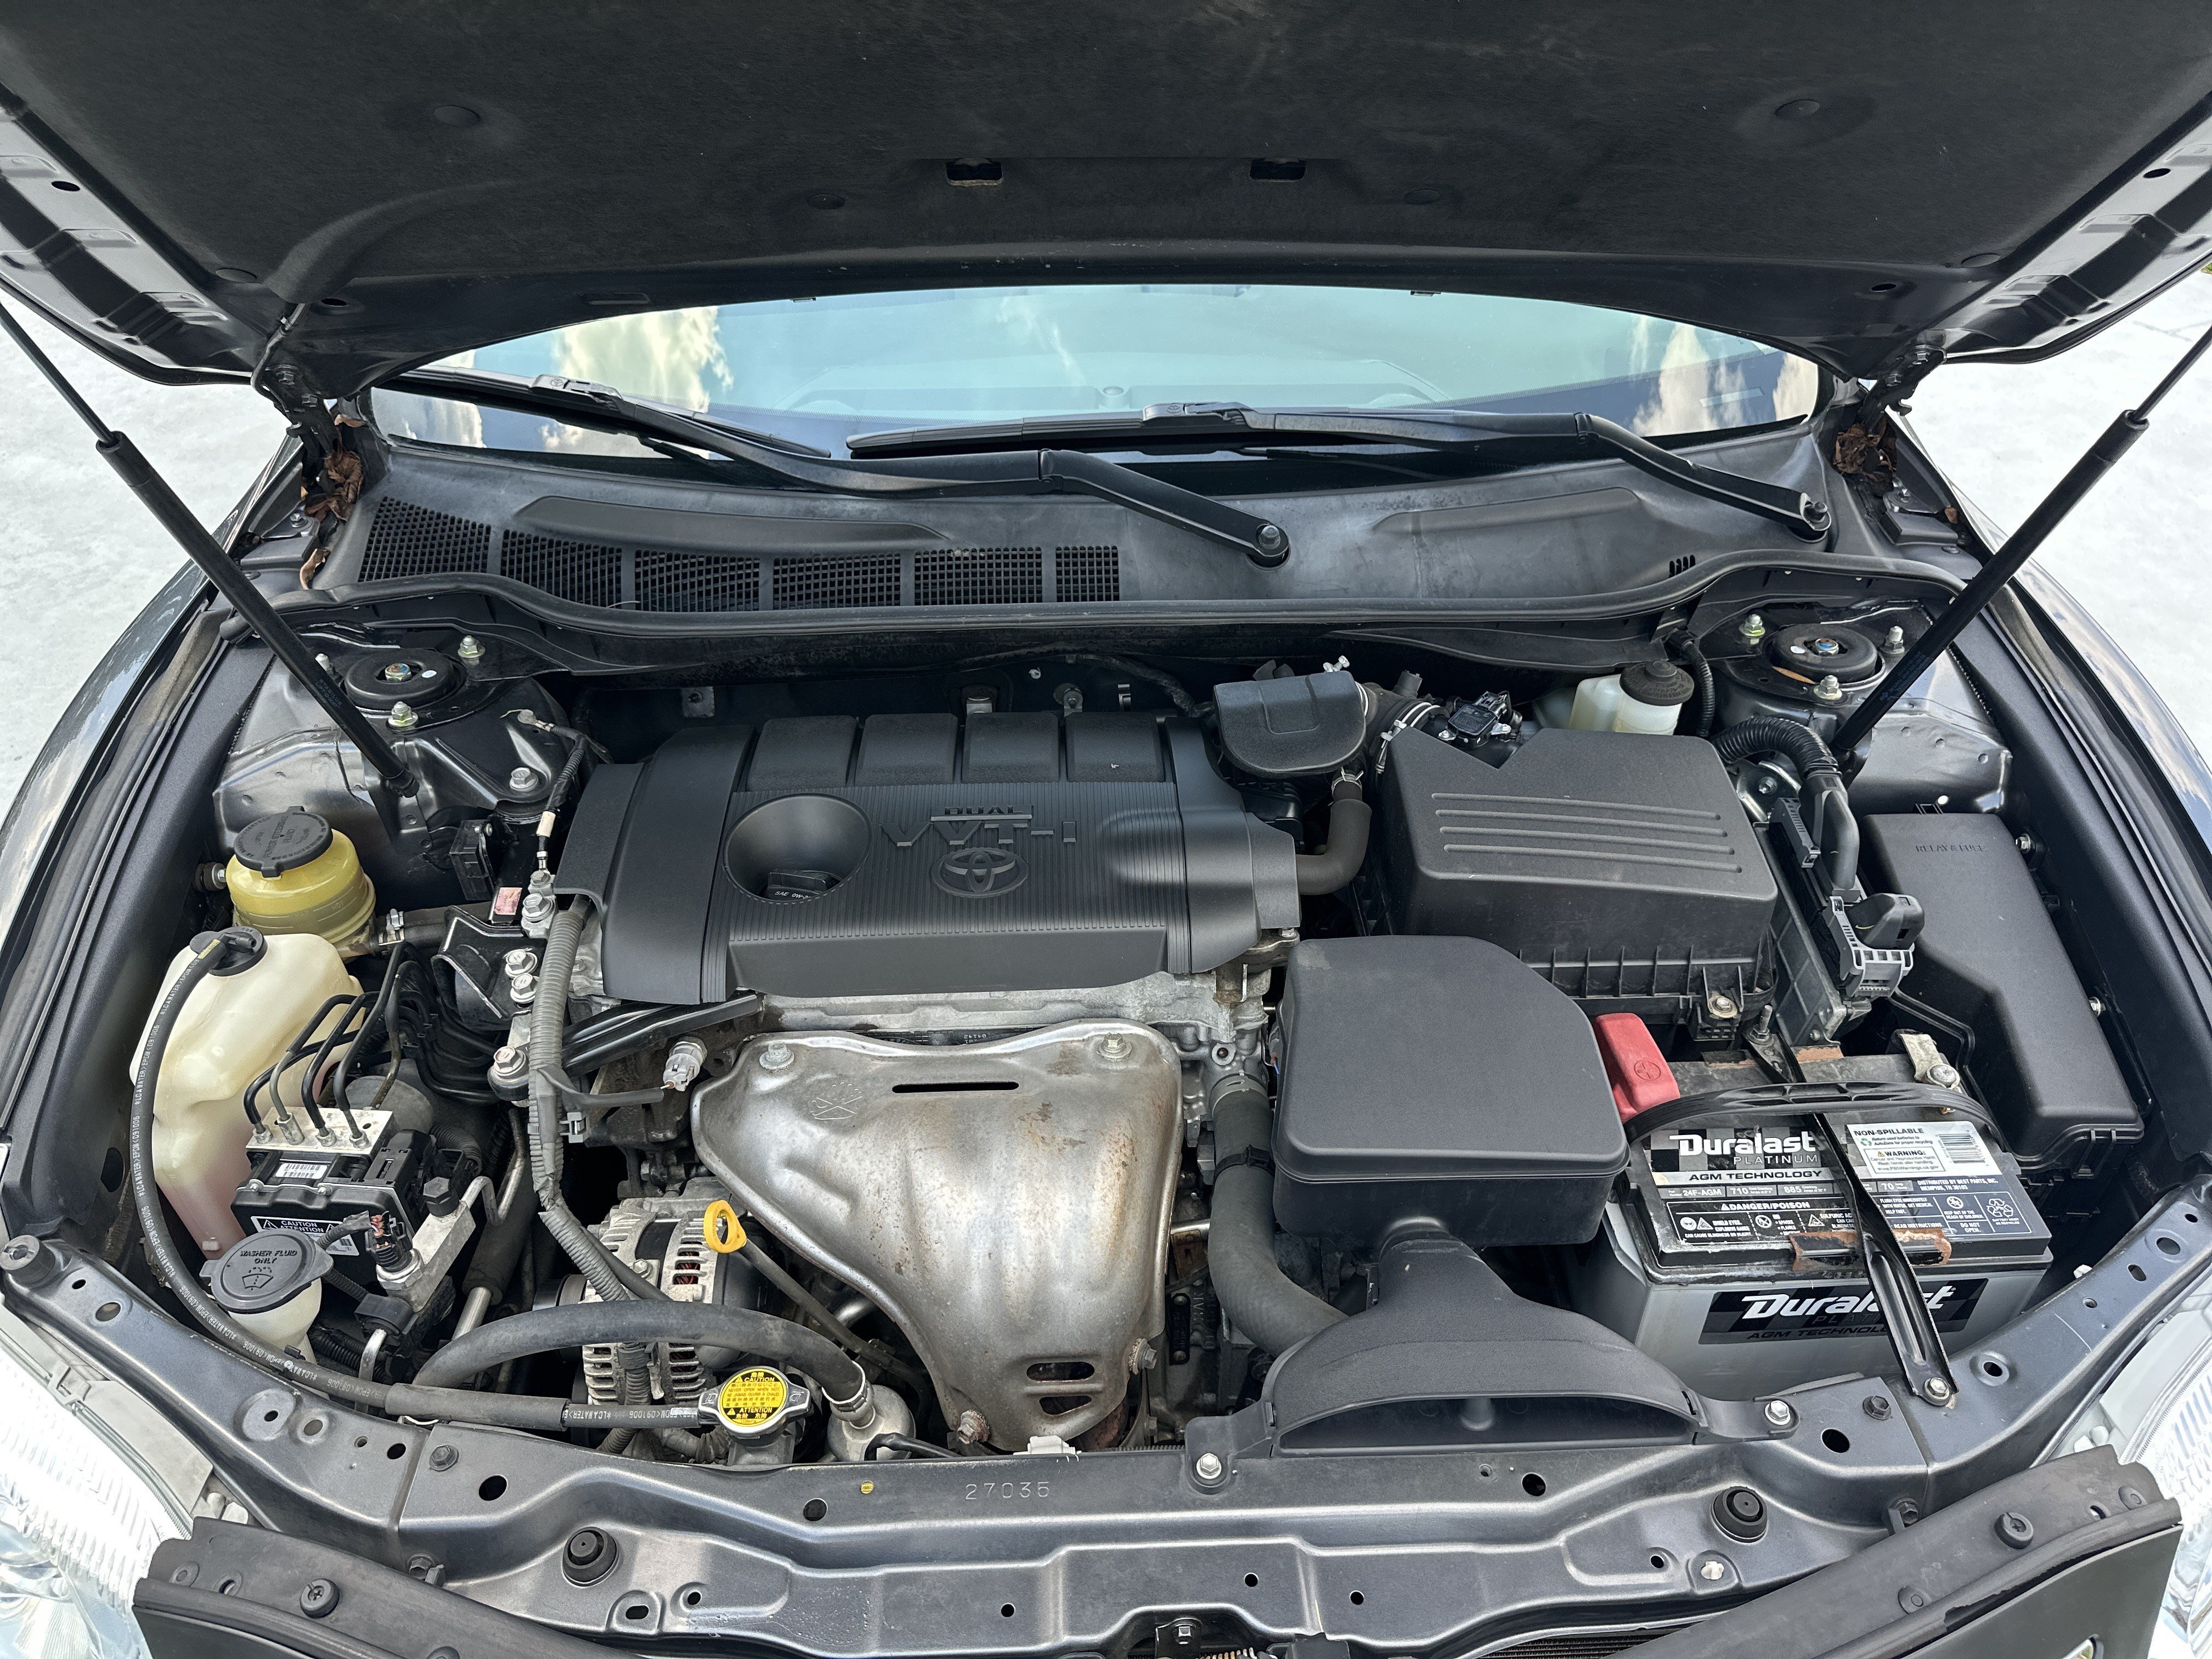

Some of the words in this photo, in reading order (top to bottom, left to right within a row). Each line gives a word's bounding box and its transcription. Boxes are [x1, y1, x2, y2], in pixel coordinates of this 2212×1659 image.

[945, 806, 1023, 815] DUAL
[1669, 1131, 1817, 1156] Duralast
[1733, 1154, 1818, 1165] PLATINUM
[1726, 1170, 1822, 1180] TECHNOLOGY
[1729, 1201, 1810, 1210] DANGER/POISON
[280, 1224, 324, 1233] ATTENTION
[1742, 1285, 1954, 1319] Duralt
[1746, 1331, 1791, 1339] AGM
[965, 1481, 1049, 1499] 27035
